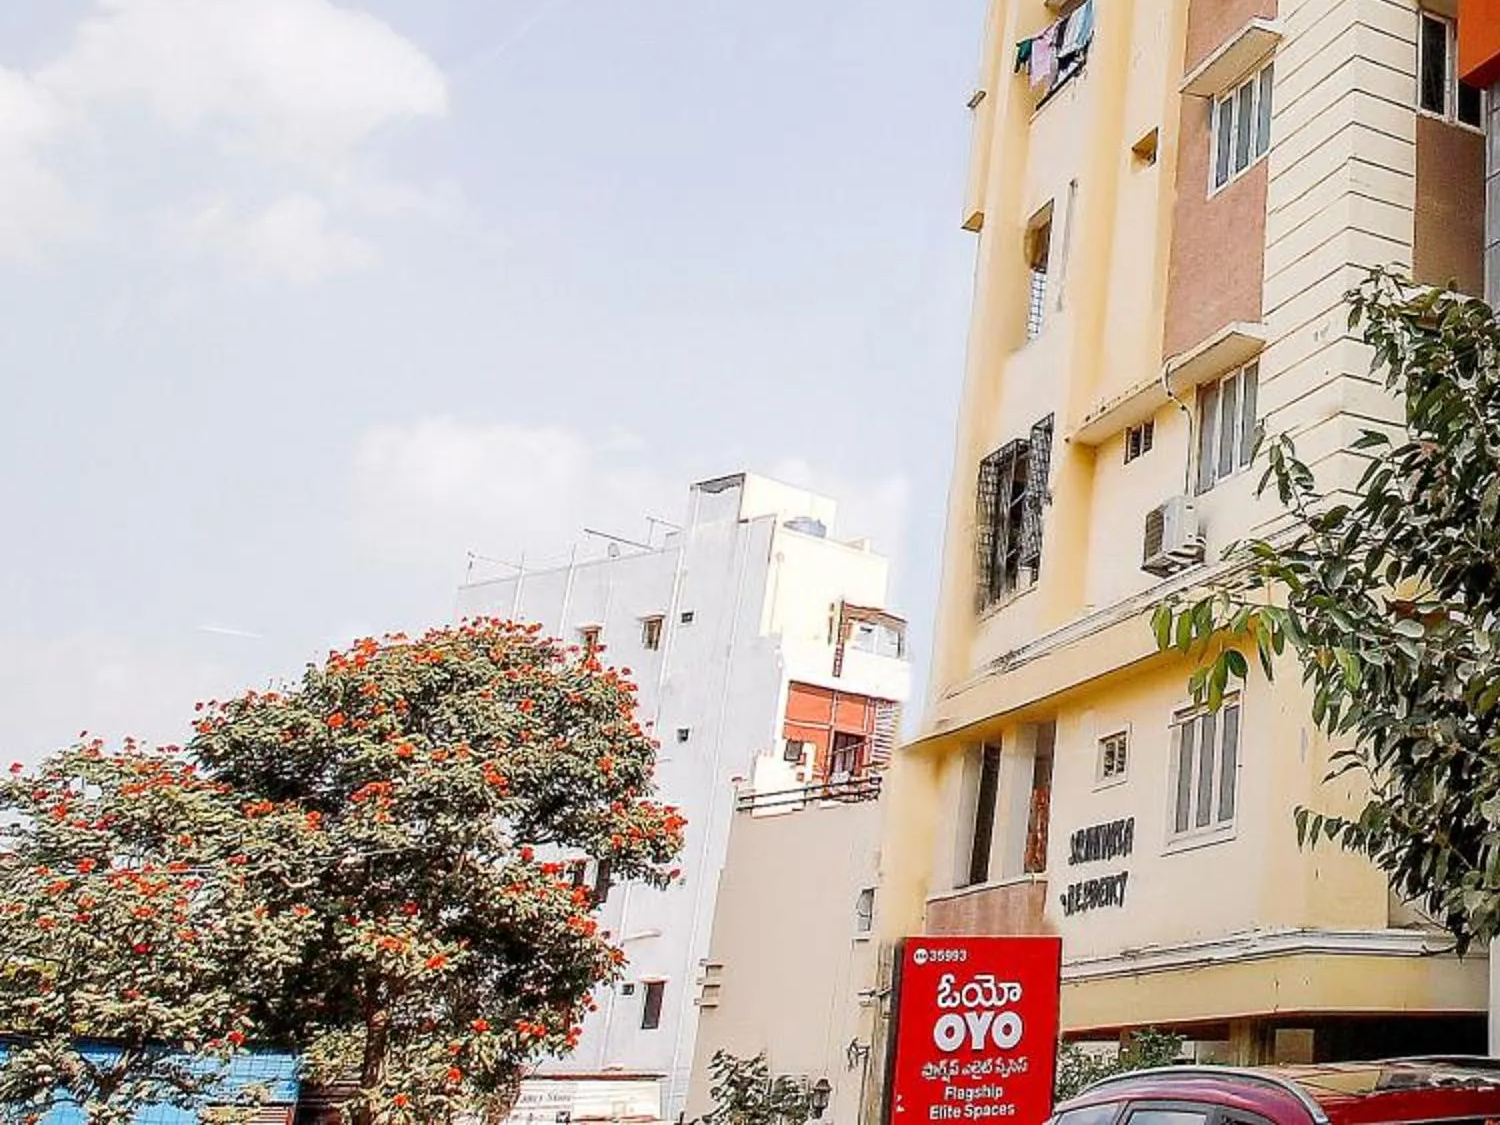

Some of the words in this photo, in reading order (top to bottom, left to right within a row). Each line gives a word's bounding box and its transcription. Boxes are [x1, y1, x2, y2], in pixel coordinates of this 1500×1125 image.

[929, 949, 967, 962] 35993
[937, 973, 1023, 1008] ఓయో
[933, 1010, 1023, 1052] OYO
[944, 1083, 1003, 1102] Flagship
[929, 1104, 961, 1120] Elite
[963, 1103, 1015, 1121] Spaces
